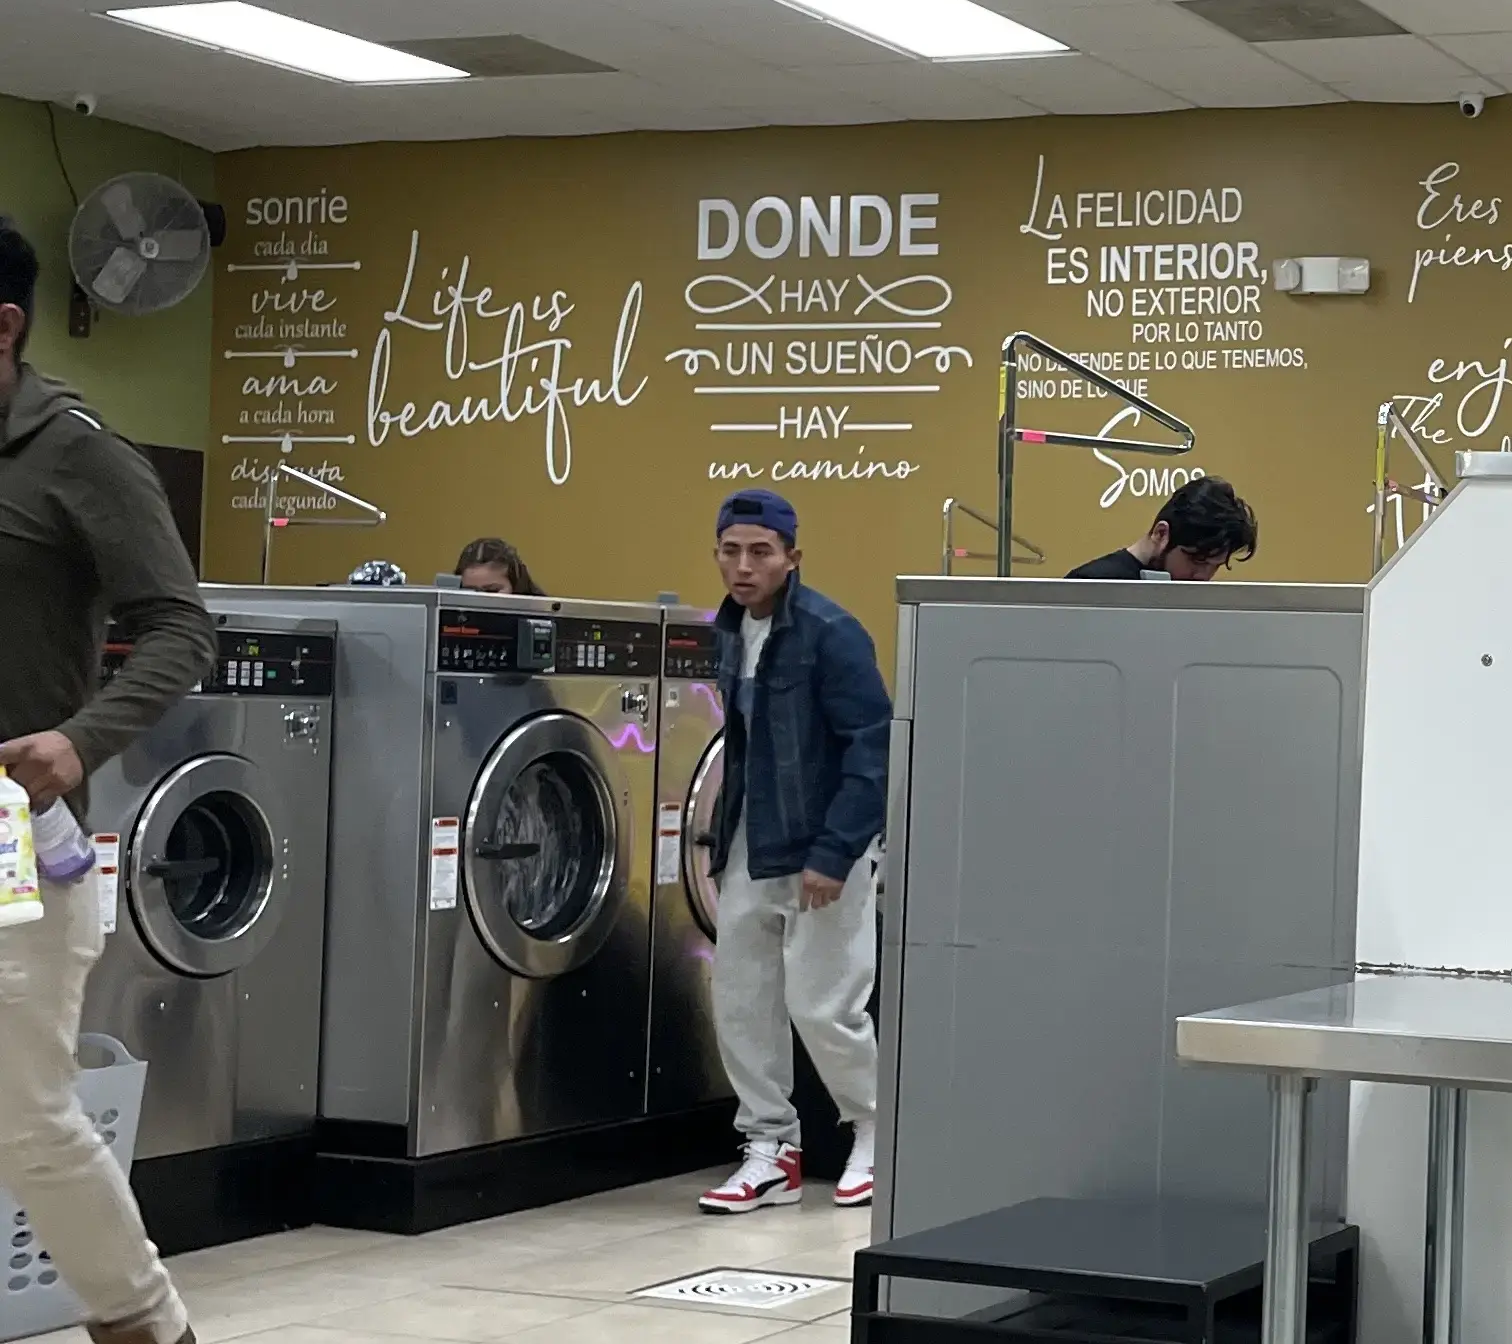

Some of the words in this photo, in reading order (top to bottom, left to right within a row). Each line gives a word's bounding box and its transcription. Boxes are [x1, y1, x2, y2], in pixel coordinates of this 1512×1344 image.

[245, 187, 348, 226] sonrie
[1018, 153, 1070, 241] LA
[1075, 186, 1244, 229] FELICIDAD
[1415, 161, 1503, 231] Eres
[254, 232, 296, 256] cada
[301, 230, 329, 255] dia
[697, 192, 940, 261] DONDE
[1046, 246, 1090, 285] ES
[1099, 241, 1269, 284] INTERIOR,
[250, 275, 337, 314] vive
[383, 229, 513, 380] Life
[531, 290, 576, 332] is
[780, 278, 850, 313] HAY
[1086, 289, 1125, 318] NO
[1130, 284, 1262, 317] EXTERIOR
[234, 317, 276, 339] cada
[279, 315, 347, 339] instante
[1131, 322, 1171, 344] POR
[1174, 321, 1199, 343] LO
[1203, 319, 1264, 342] TANTO
[726, 340, 774, 376] UN
[785, 333, 913, 376] SUEÑO
[1016, 352, 1043, 373] NO
[1045, 351, 1124, 373] DENDE
[1127, 351, 1151, 372] DE
[1154, 350, 1178, 371] LO
[1180, 349, 1217, 372] QUE
[1221, 346, 1309, 371] TENEMOS,
[241, 374, 338, 397] ama
[367, 280, 649, 486] beautiful
[1016, 379, 1057, 400] SINO
[1060, 379, 1084, 399] DE
[239, 410, 249, 424] a
[252, 402, 293, 424] cada
[297, 400, 336, 424] hora
[779, 405, 850, 439] HAY
[1390, 391, 1454, 446] The
[708, 460, 764, 480] un
[771, 444, 920, 482] camino
[231, 486, 267, 509] cada
